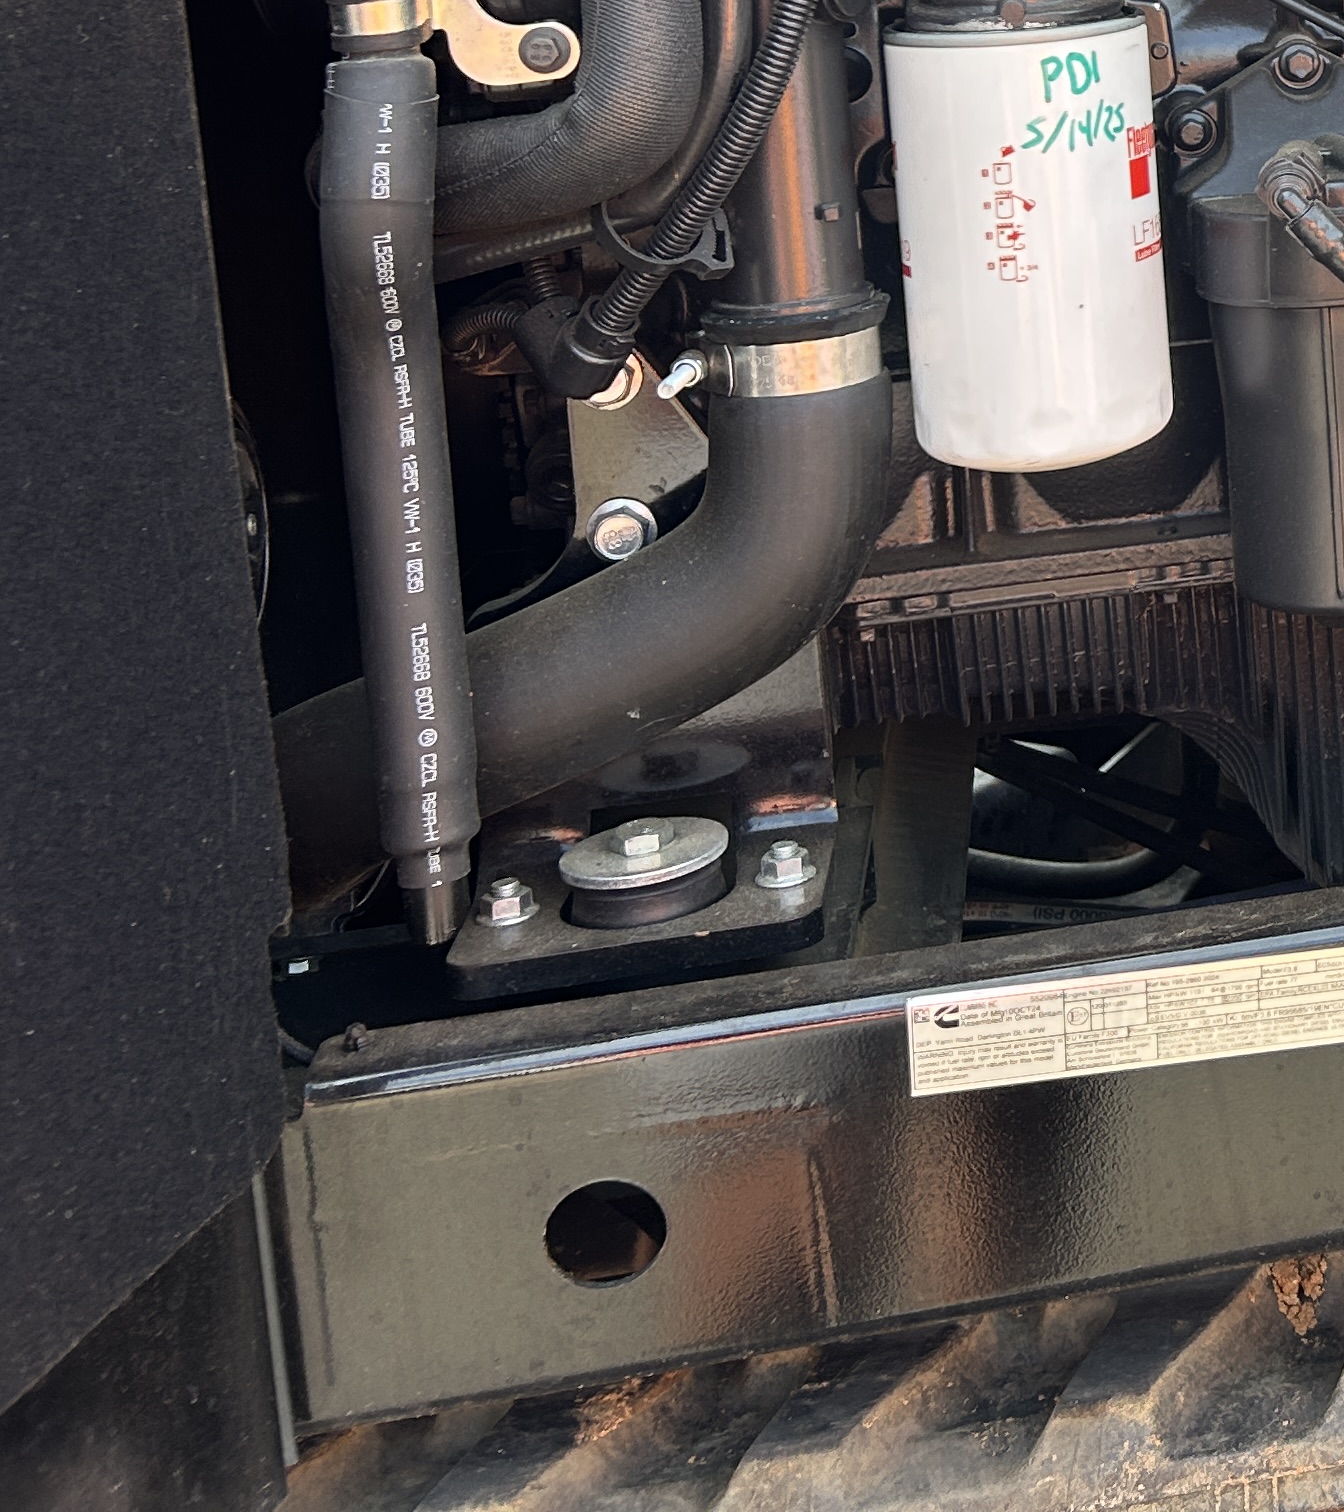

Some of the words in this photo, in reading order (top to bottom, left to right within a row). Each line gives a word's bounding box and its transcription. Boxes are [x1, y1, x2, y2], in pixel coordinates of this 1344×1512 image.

[1040, 50, 1101, 103] PDI
[1020, 98, 1126, 153] 5/14/25
[375, 143, 392, 155] H
[398, 412, 417, 448] TUBE
[403, 498, 422, 535] VW-1
[405, 541, 423, 553] H
[410, 622, 432, 683] TL52668
[414, 686, 436, 721] 600V
[419, 753, 438, 788] CZCL
[421, 791, 441, 844] RSFR-H
